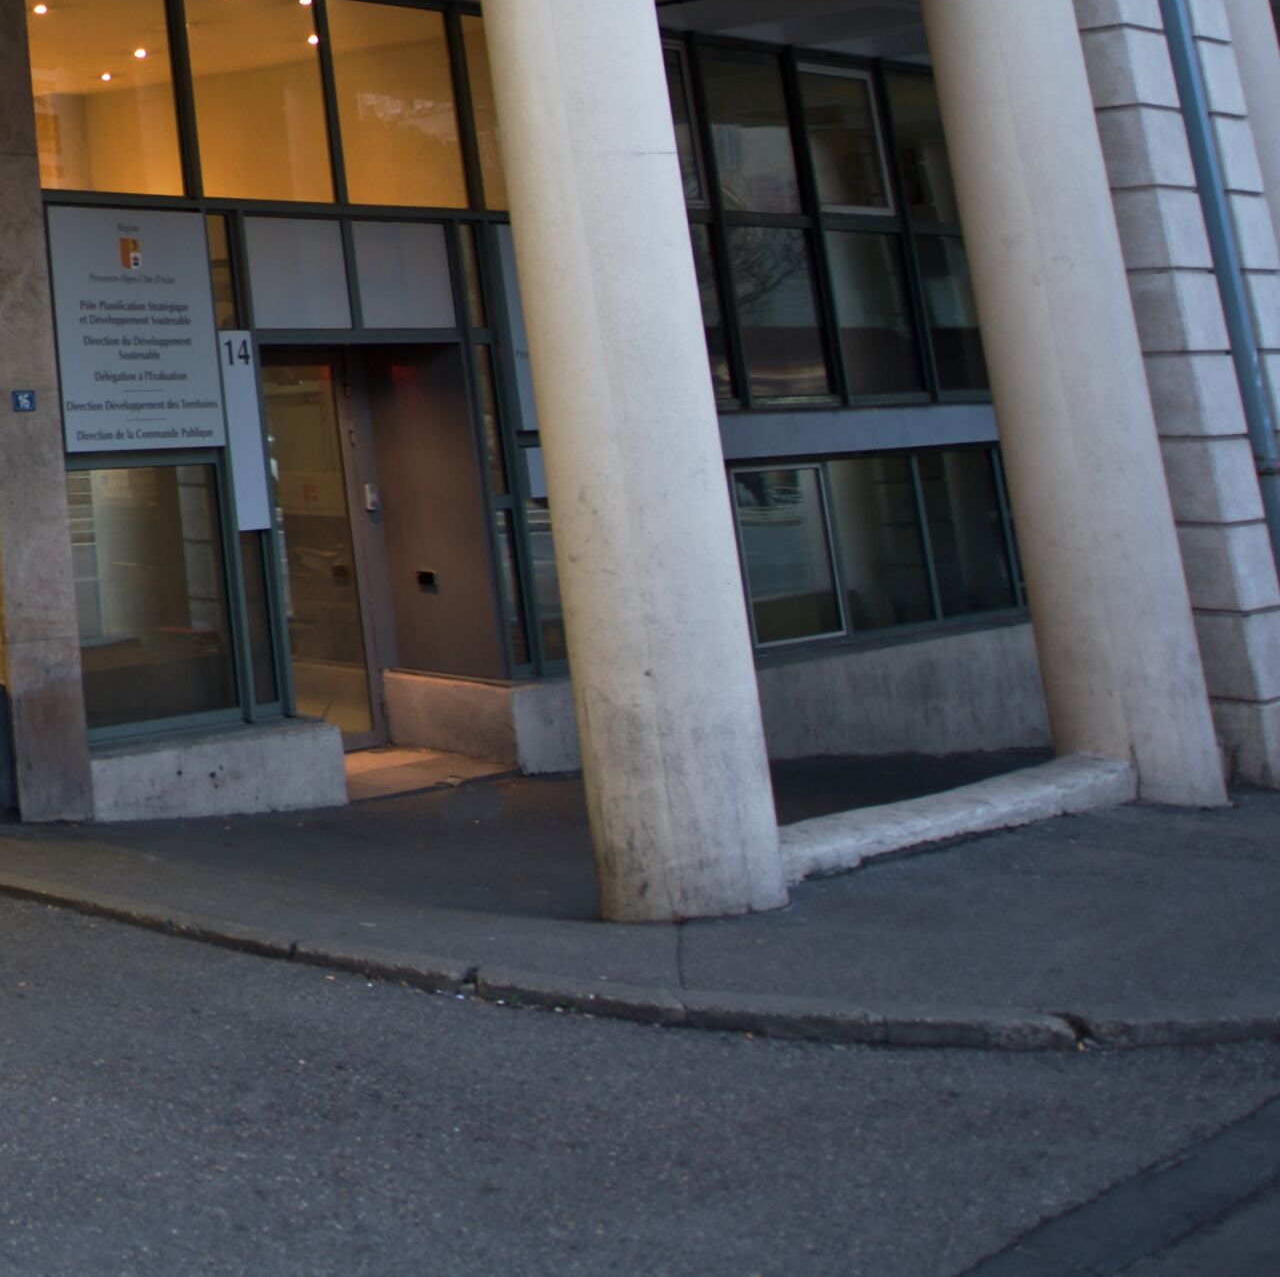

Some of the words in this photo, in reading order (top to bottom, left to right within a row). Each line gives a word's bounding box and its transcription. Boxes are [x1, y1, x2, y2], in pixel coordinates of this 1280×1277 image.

[83, 335, 120, 346] Direction
[223, 339, 251, 366] 14
[66, 400, 104, 411] Direction
[76, 429, 114, 442] Direction
